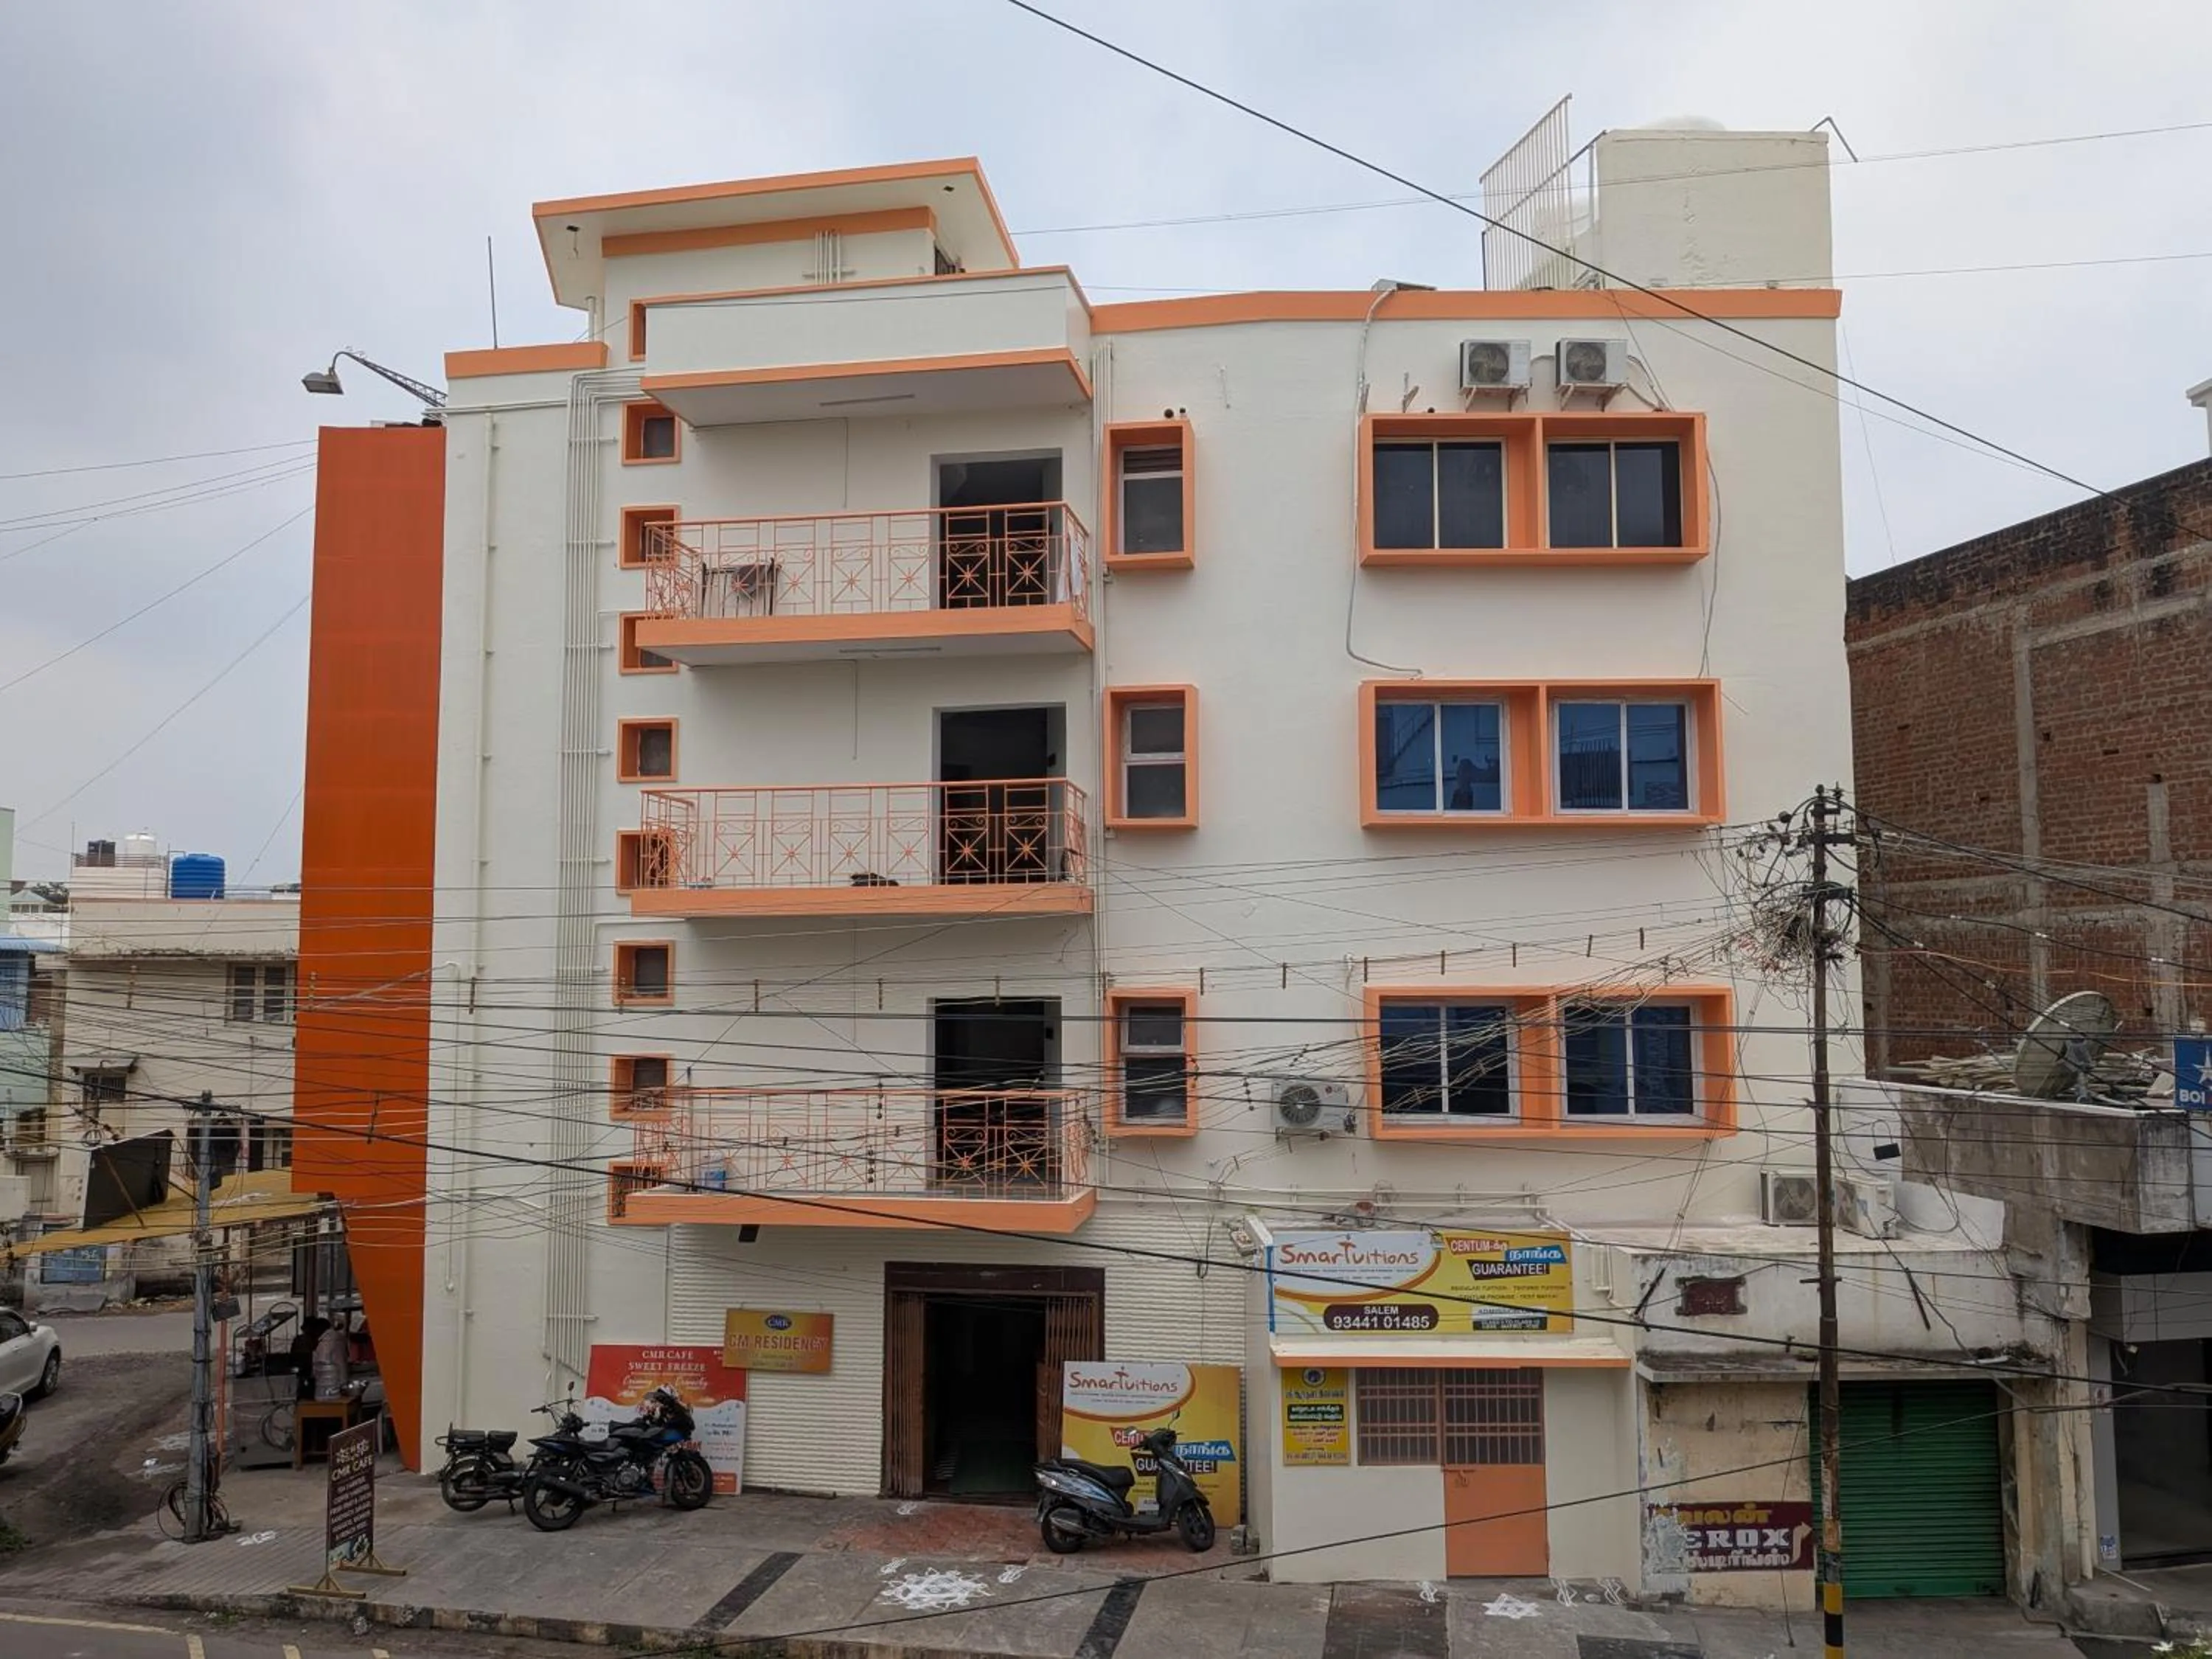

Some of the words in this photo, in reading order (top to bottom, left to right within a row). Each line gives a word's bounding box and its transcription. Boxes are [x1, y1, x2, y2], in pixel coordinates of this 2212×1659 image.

[1472, 1262, 1547, 1275] GUARANTEE!
[1363, 1306, 1399, 1315] SALEM
[1333, 1316, 1378, 1329] 93441
[1383, 1316, 1430, 1329] 01485
[667, 1350, 694, 1360] CAFE
[628, 1362, 662, 1371] SWEET
[667, 1362, 706, 1371] FREEZE
[1069, 1371, 1178, 1393] SmarTuitions
[1136, 1458, 1214, 1472] GUATEE!
[1686, 1528, 1790, 1548] EROX
